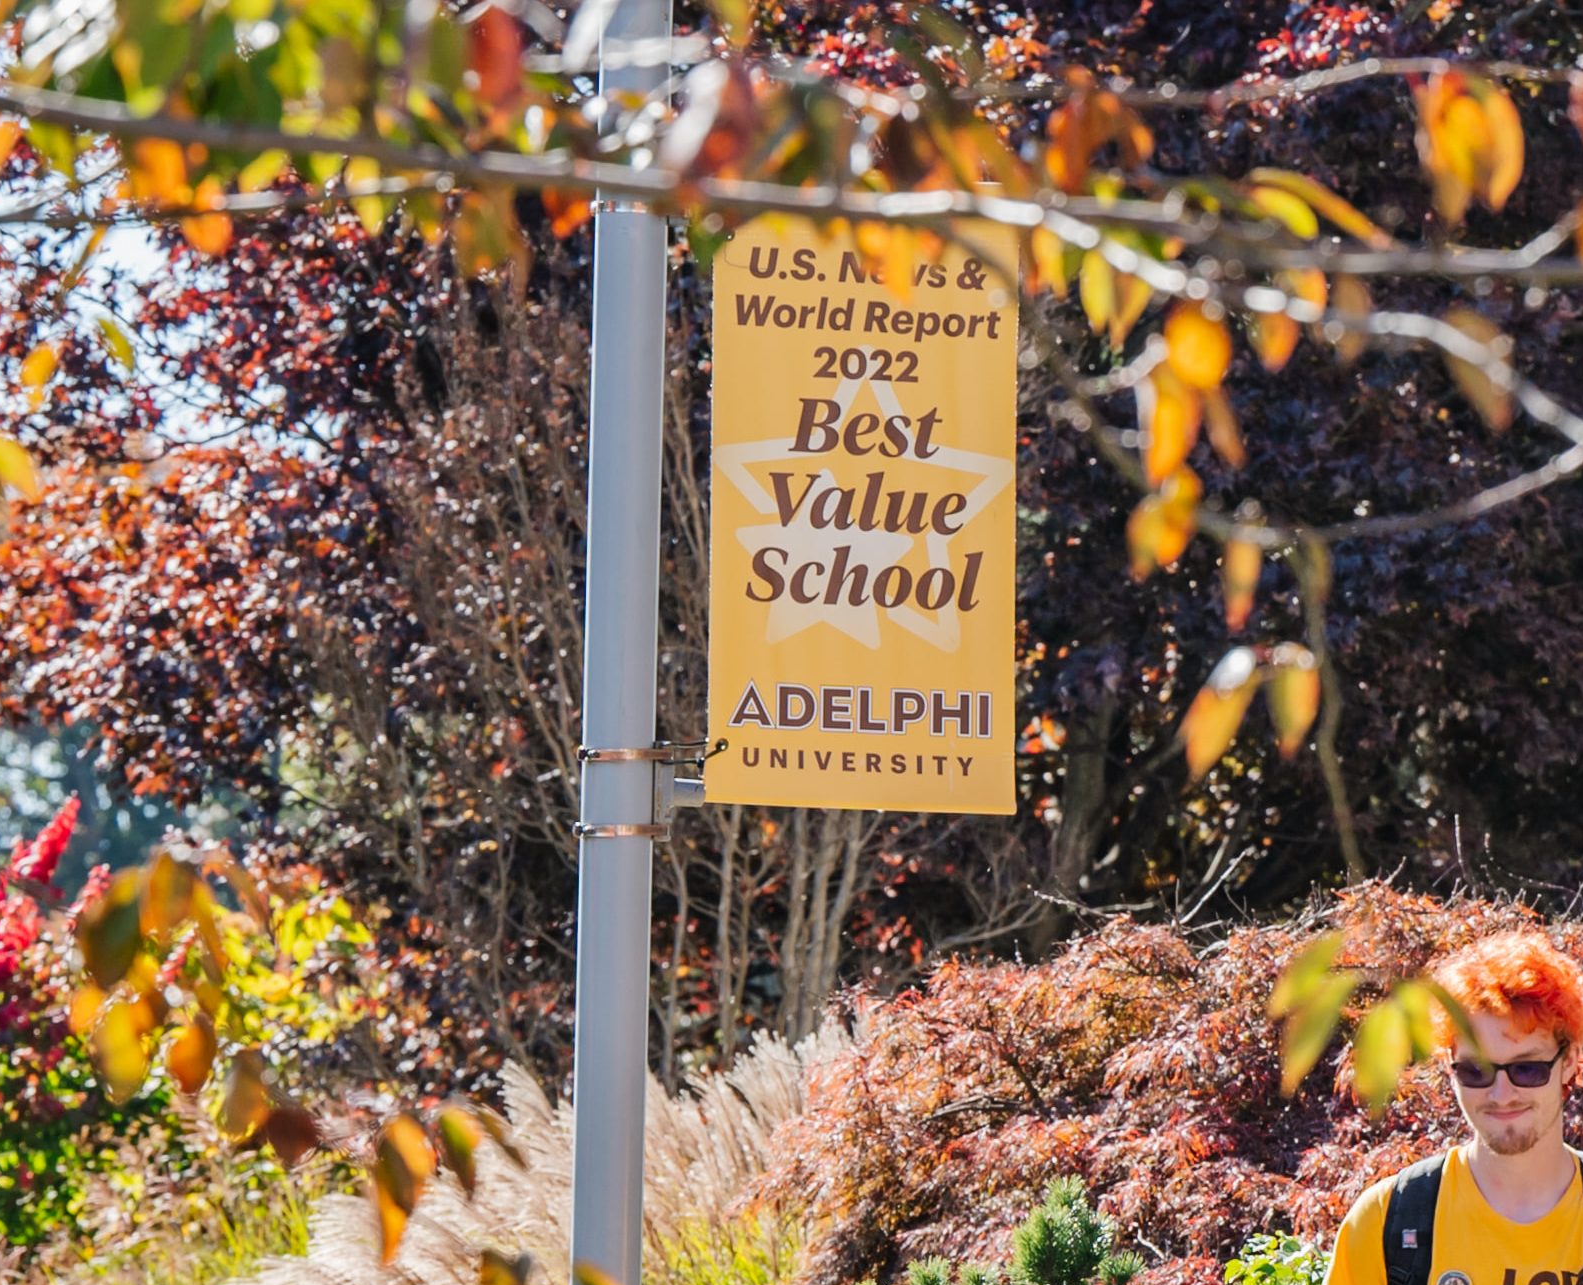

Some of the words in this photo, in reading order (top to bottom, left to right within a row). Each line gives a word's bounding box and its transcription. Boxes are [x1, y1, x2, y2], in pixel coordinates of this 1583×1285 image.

[749, 247, 826, 282] U.S.
[956, 258, 987, 291] &
[735, 294, 855, 331] World
[863, 301, 1001, 343] Report
[813, 346, 919, 383] 2022
[788, 397, 943, 459] Best
[769, 471, 967, 535] Value
[745, 545, 984, 612] School
[727, 679, 993, 739] ADELPHI
[742, 747, 973, 777] UNIVERSITY
